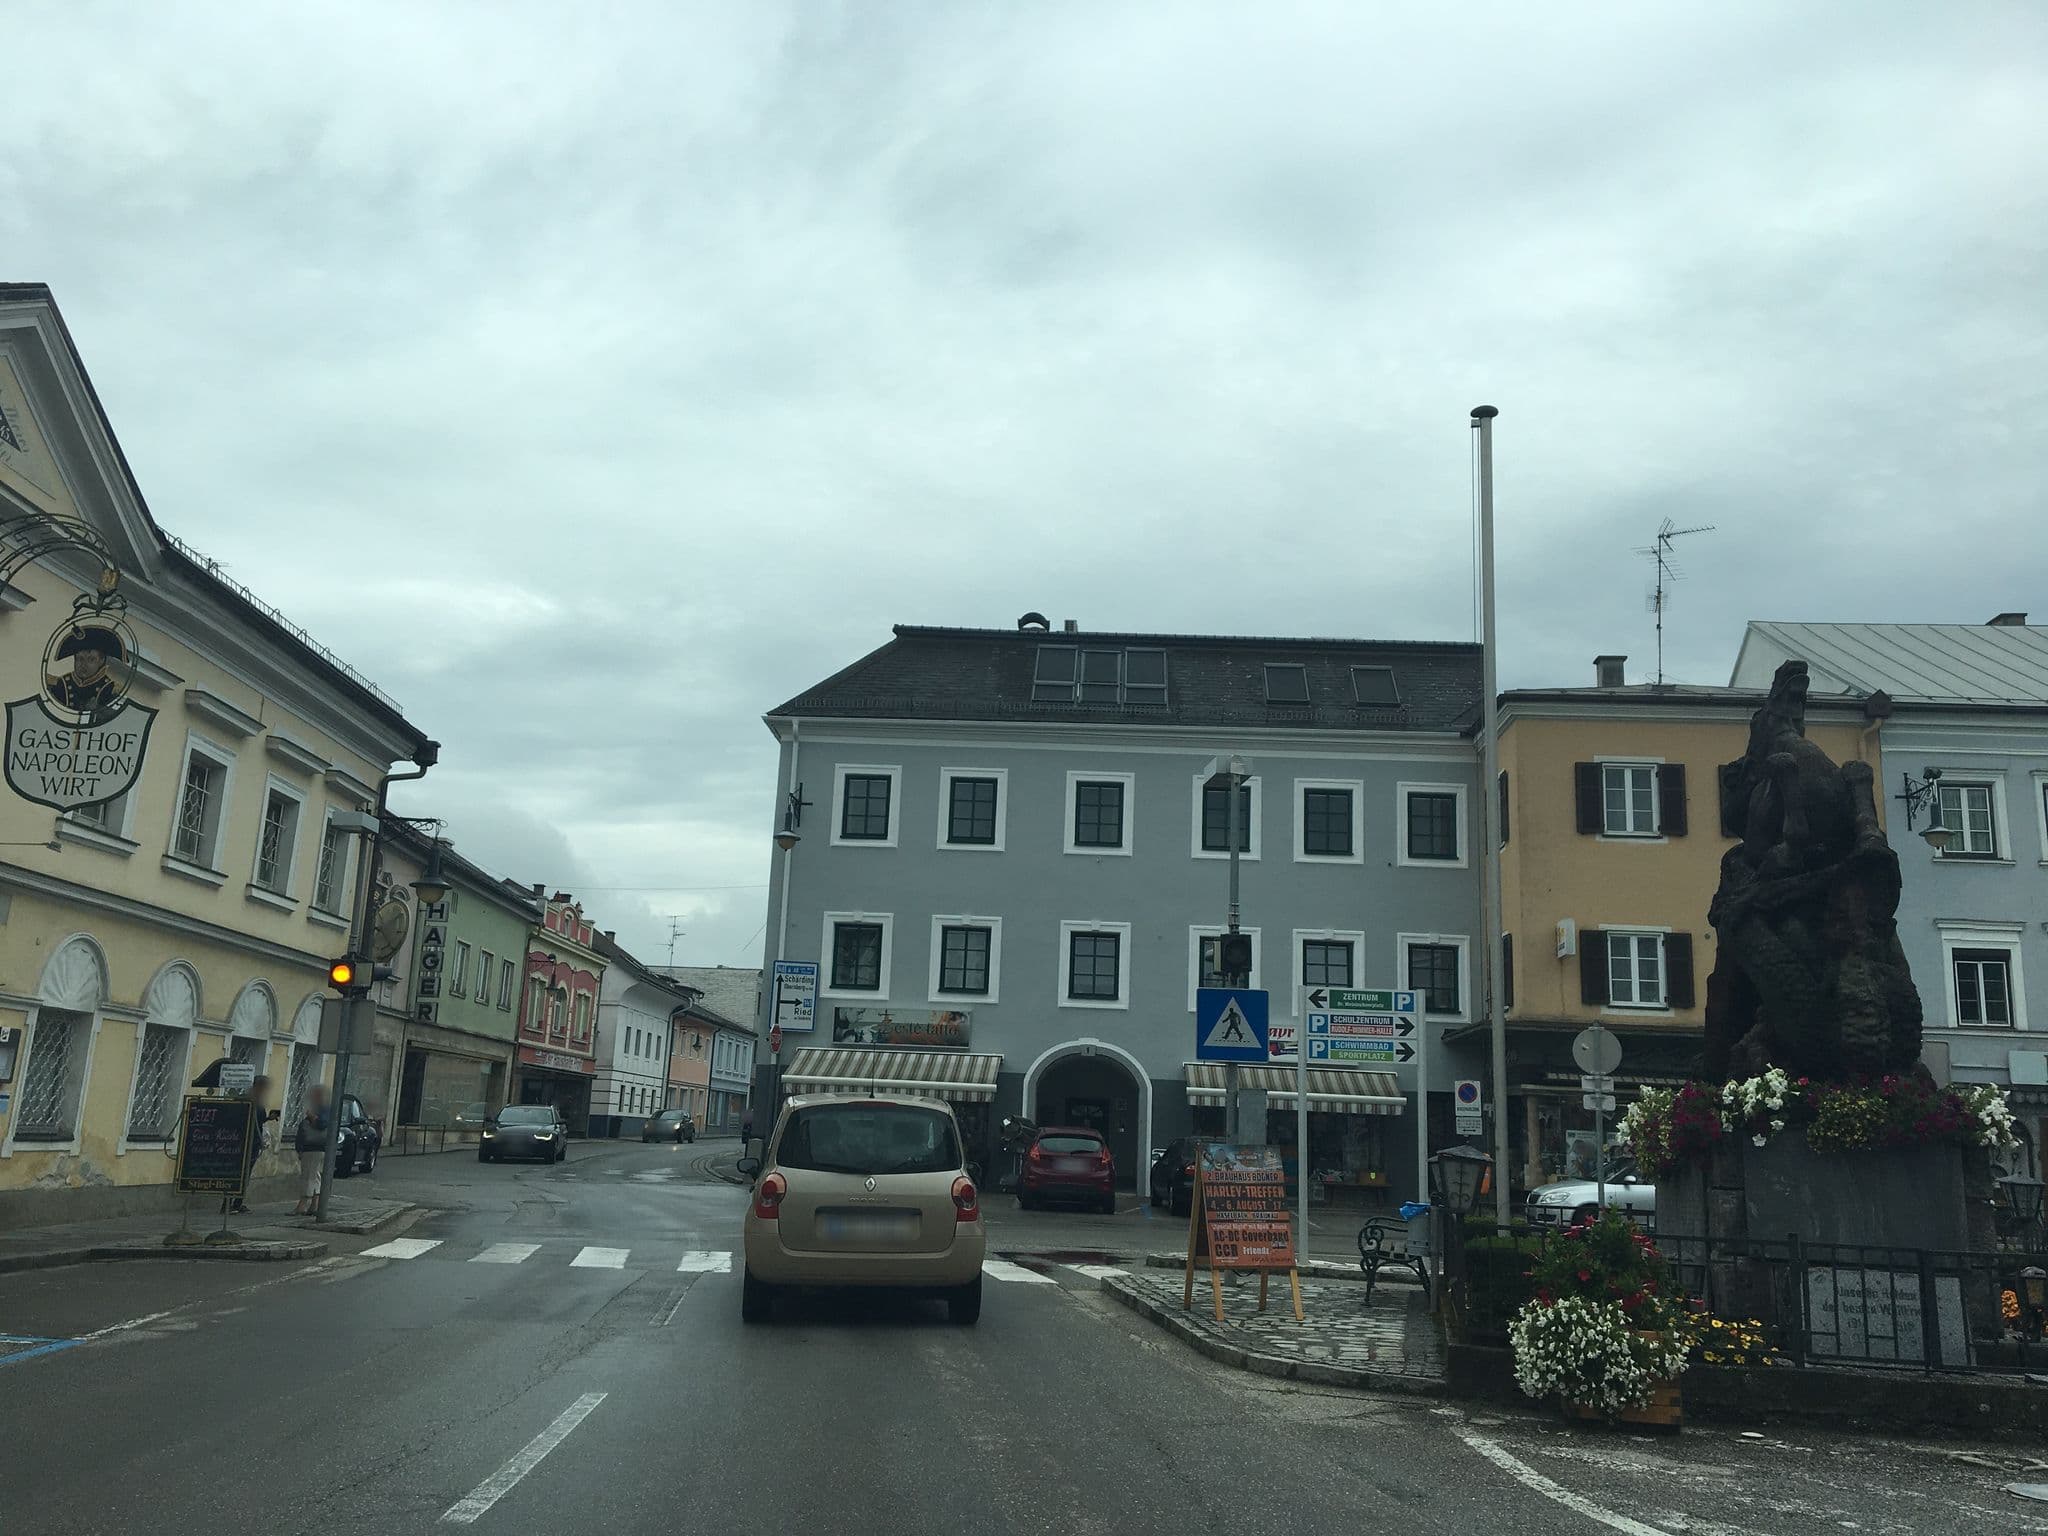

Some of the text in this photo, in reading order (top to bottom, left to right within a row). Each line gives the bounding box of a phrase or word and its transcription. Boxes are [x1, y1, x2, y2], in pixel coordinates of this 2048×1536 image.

[18, 728, 138, 753] GASTHOF
[40, 775, 102, 797] WIRT
[417, 903, 446, 1021] HAGER
[1342, 993, 1379, 1002] ZENTRUM
[1397, 994, 1411, 1010] P
[794, 1007, 812, 1016] Ried
[1311, 1015, 1325, 1032] P
[1333, 1016, 1390, 1025] SCHULZENTRUM
[1311, 1041, 1325, 1057] P
[1335, 1041, 1389, 1050] SCHWIMMBAD
[1339, 1050, 1385, 1060] SPORTPLATZ
[1205, 1185, 1285, 1198] HARLEY-TREFFEN
[1236, 1200, 1267, 1211] AUGUST
